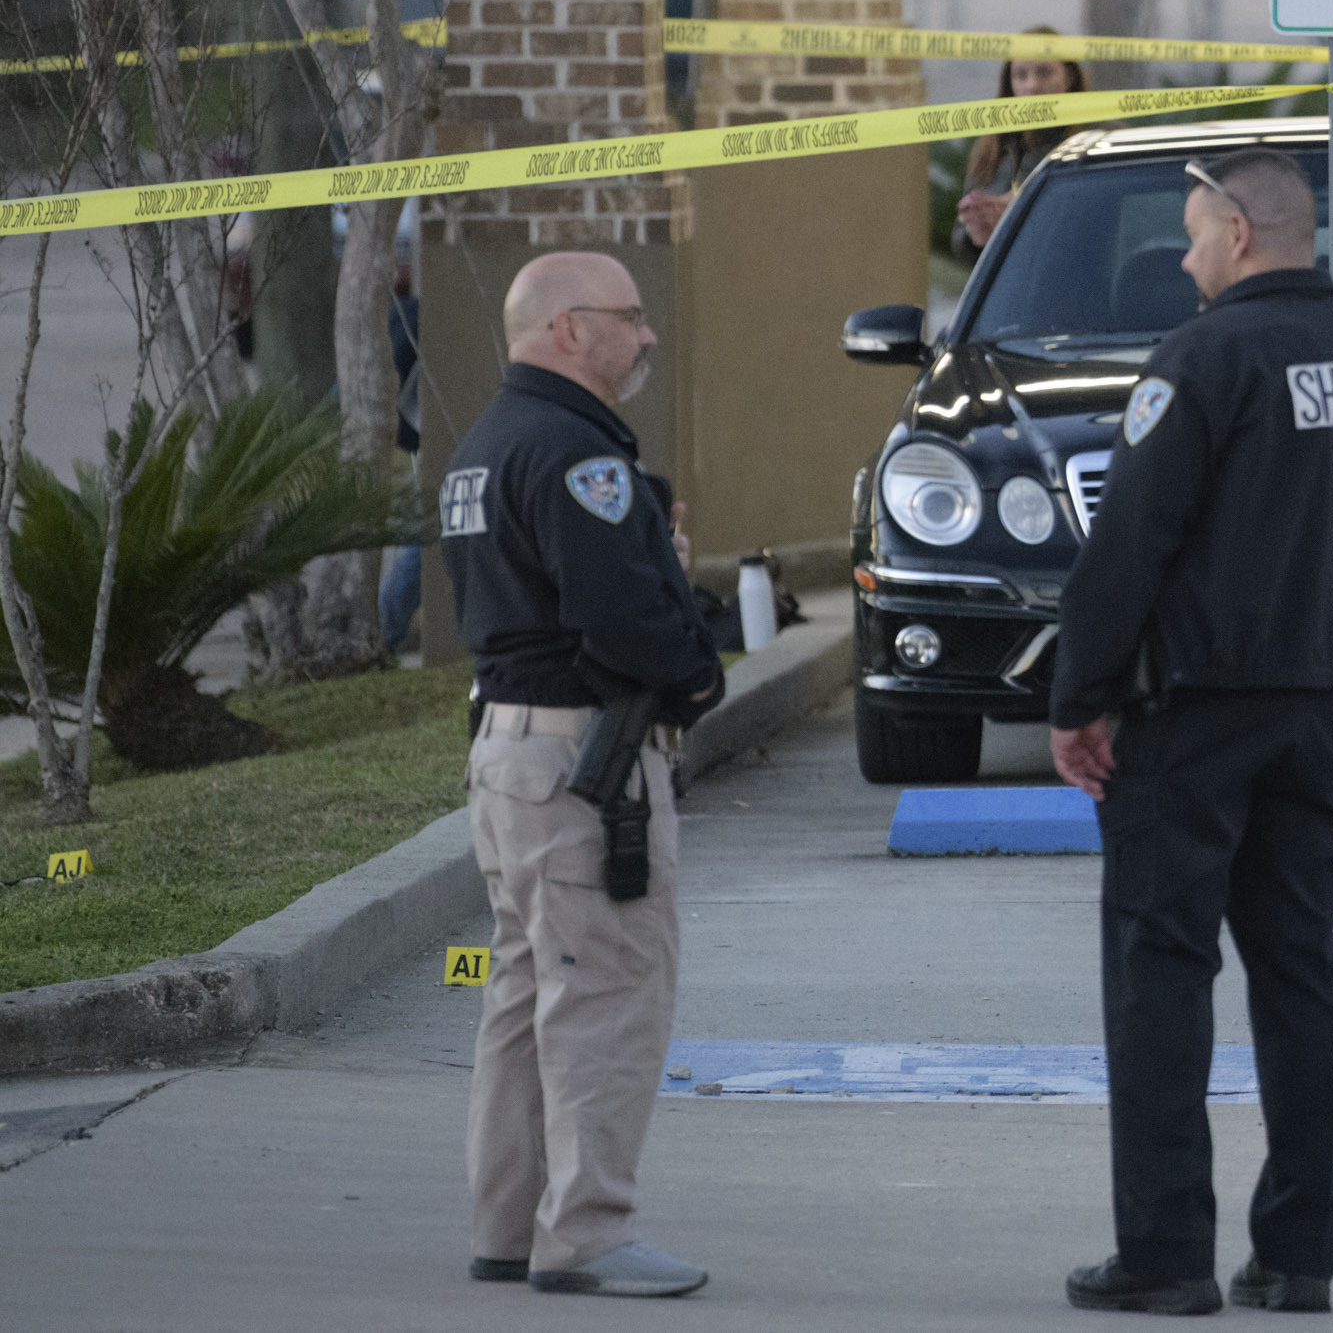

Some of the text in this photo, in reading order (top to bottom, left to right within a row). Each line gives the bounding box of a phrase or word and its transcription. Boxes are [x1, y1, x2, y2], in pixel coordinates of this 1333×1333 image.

[721, 119, 858, 157] SHERIFF'S LINE DO NOT CROSS
[526, 140, 664, 178] SHERIFF'S LINE DO NOT CROSS
[327, 160, 470, 197] SHERIFF'S LINE DO NOT CROSS
[33, 197, 81, 226] SHERIFF'S
[134, 179, 272, 216] SHERIFF'S LINE DO NOT CROSS
[11, 202, 34, 228] LINE
[53, 856, 82, 879] AJ
[452, 954, 483, 978] AI
